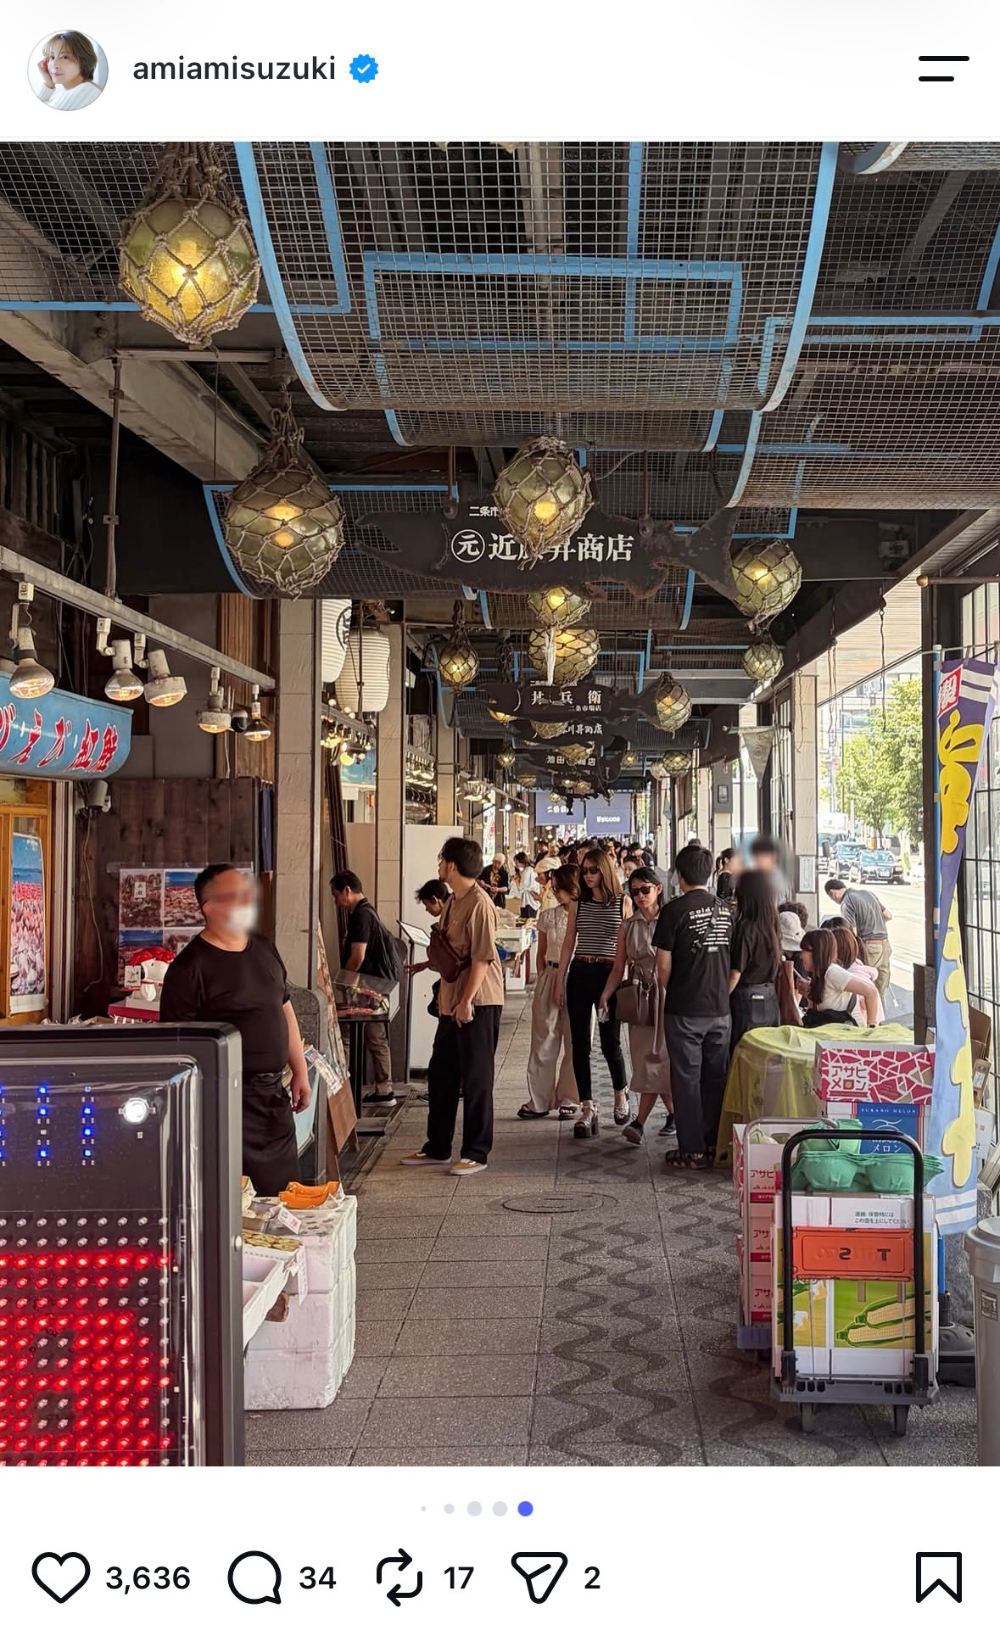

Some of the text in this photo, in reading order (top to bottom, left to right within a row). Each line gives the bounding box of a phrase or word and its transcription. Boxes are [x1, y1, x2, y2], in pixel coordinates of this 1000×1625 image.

[488, 532, 634, 562] 近昇商店
[831, 1066, 867, 1078] アサヒ
[831, 1078, 867, 1090] メロン
[872, 1144, 902, 1153] メロン
[750, 1169, 774, 1179] アサヒ
[754, 1288, 773, 1297] アサ
